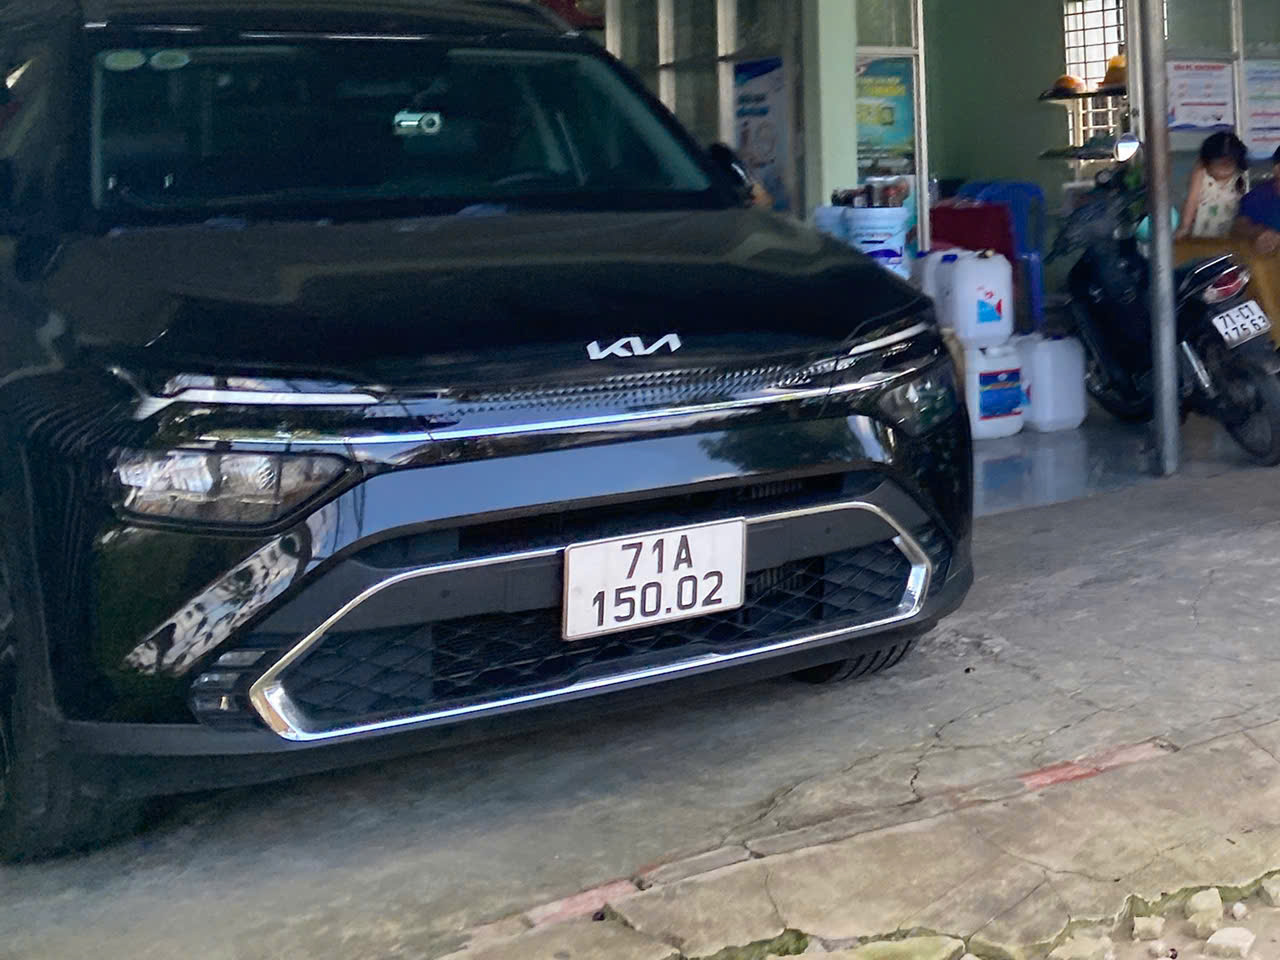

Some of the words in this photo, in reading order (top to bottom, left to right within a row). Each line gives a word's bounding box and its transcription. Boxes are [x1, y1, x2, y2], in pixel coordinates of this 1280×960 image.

[586, 333, 682, 361] KIA
[621, 534, 694, 581] 71A
[592, 570, 724, 628] 150.02
